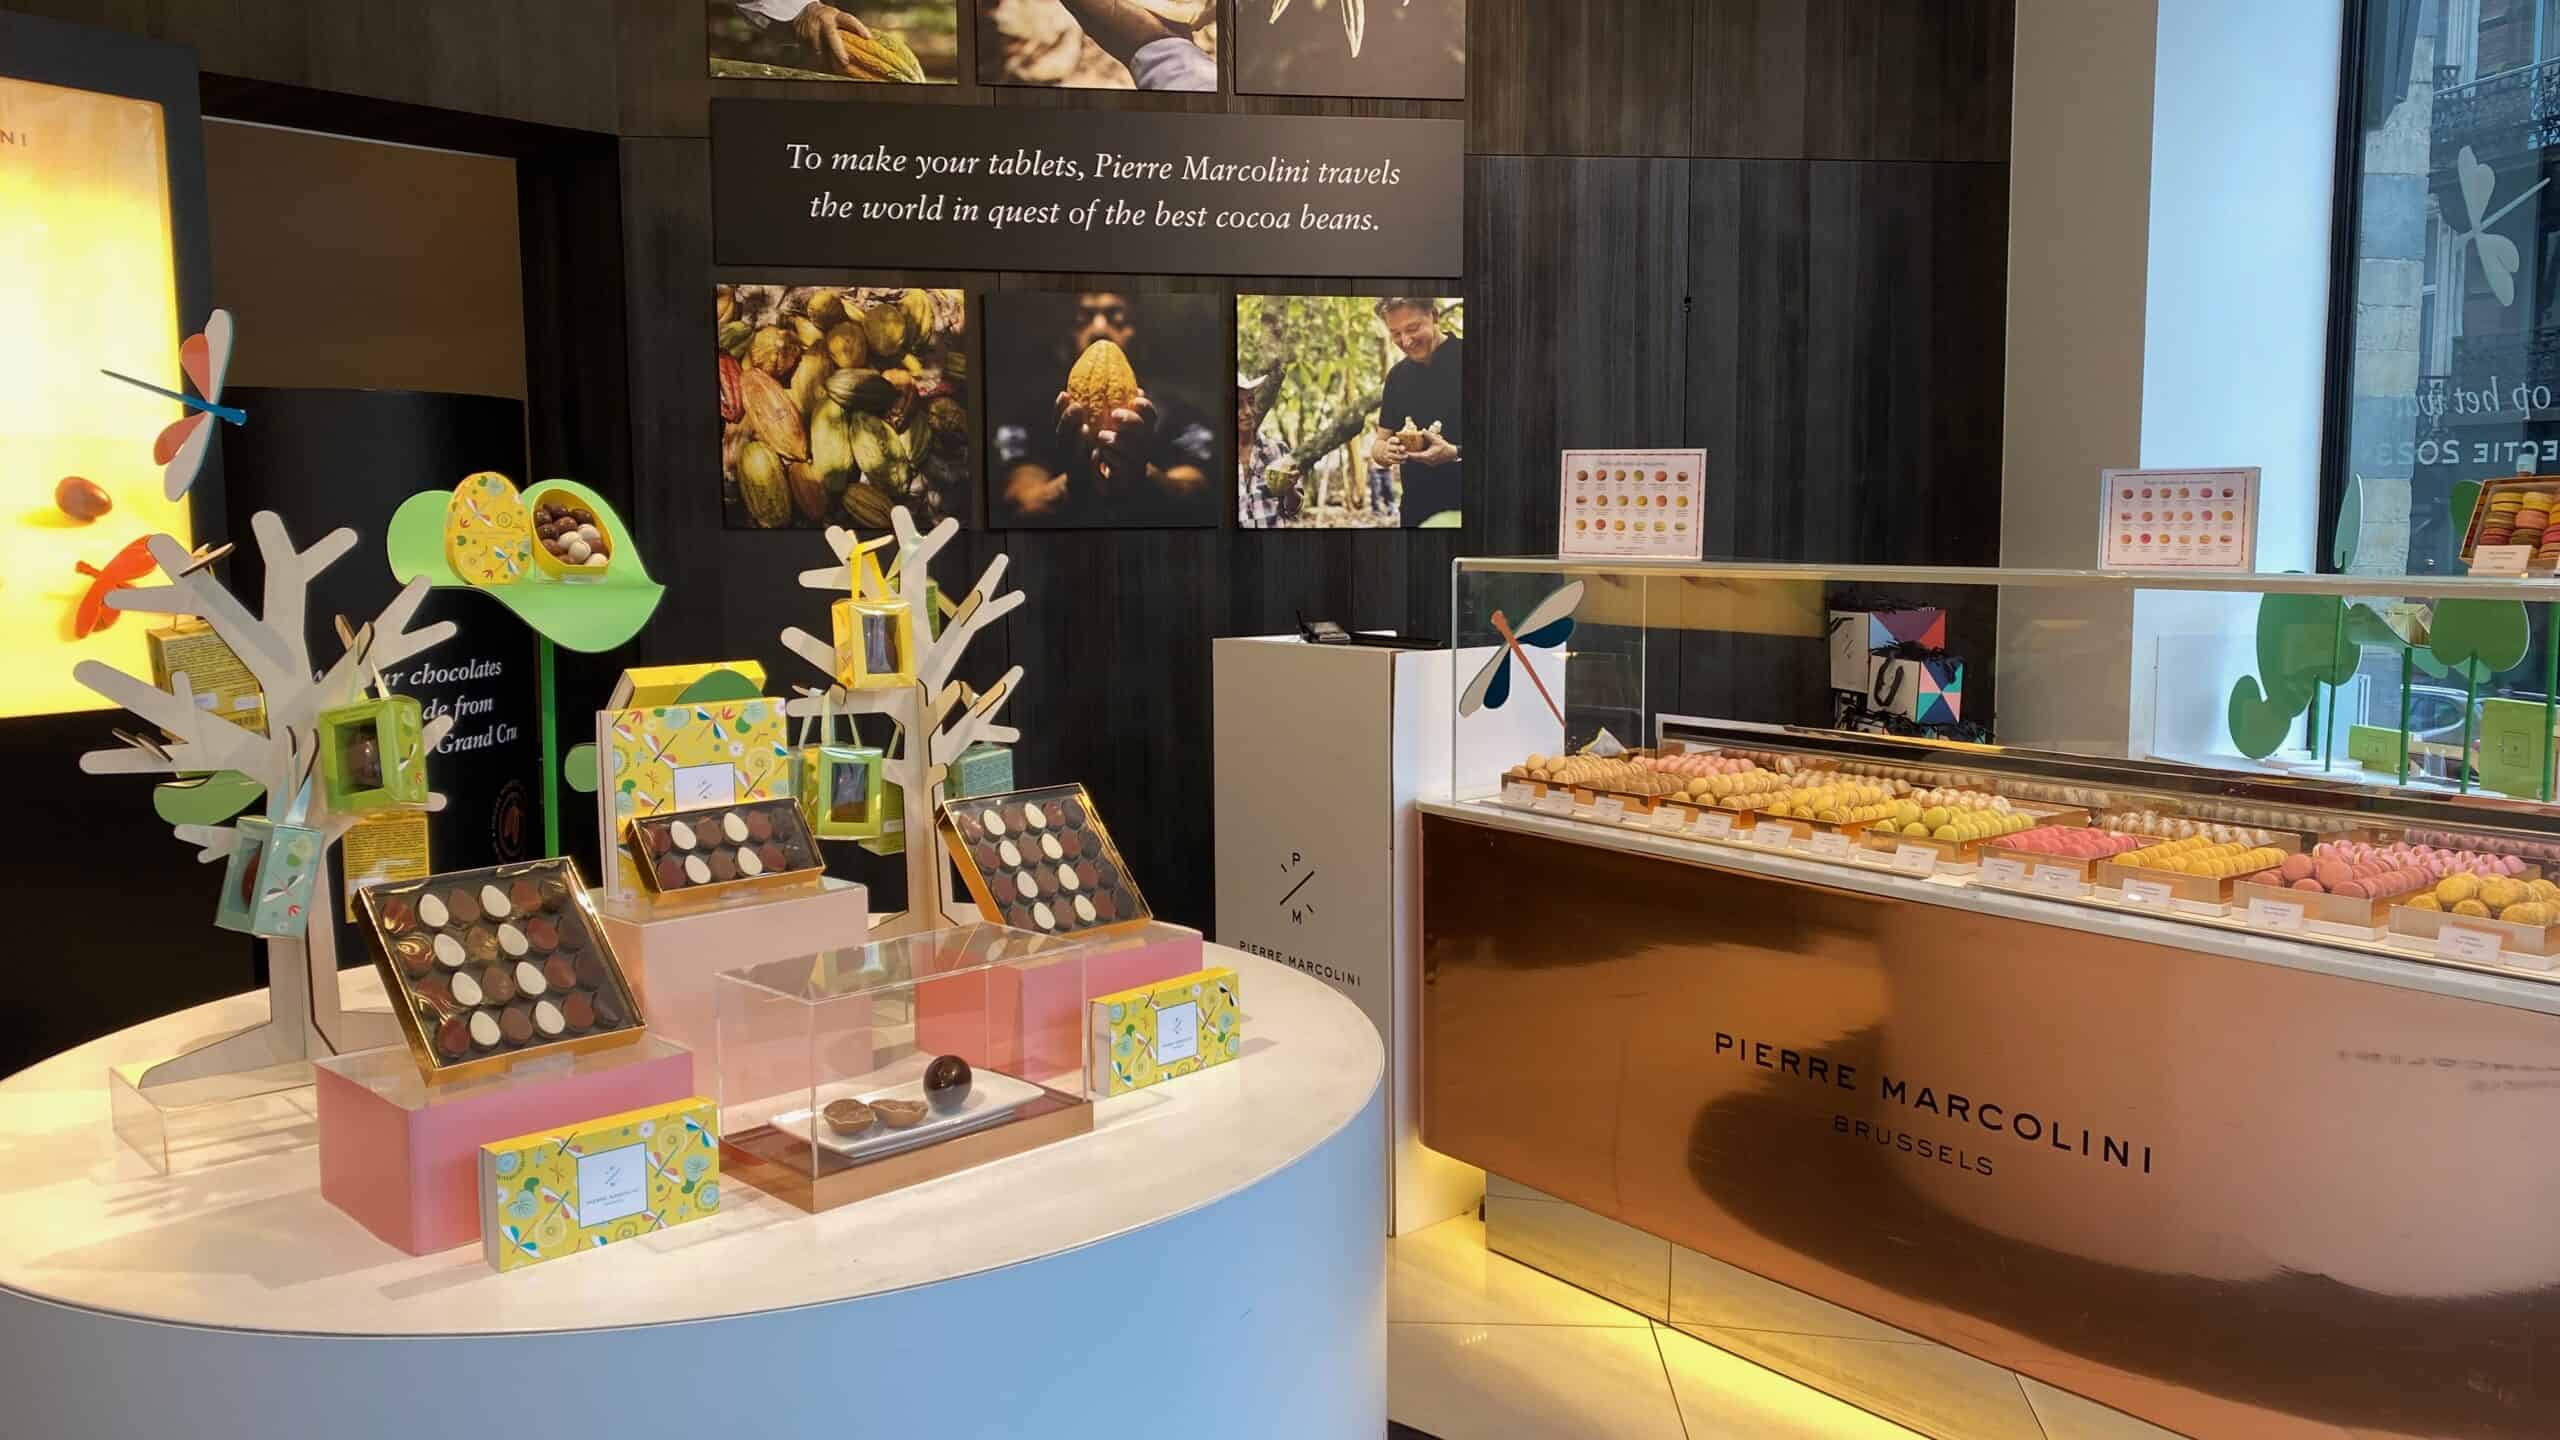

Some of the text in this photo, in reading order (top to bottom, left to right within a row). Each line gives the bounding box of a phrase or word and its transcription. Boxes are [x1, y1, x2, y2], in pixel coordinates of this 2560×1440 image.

[786, 143, 1400, 185] To make your tablets, Pierre Marcolini travels
[810, 191, 1380, 231] the world in quest of the best cocoa beans.
[409, 658, 502, 686] chocolates
[422, 695, 494, 722] de from
[435, 723, 518, 754] Grand Cru
[1291, 852, 1301, 867] P
[1291, 909, 1302, 925] M
[1239, 940, 1362, 987] PIERRE MARCOLINI
[1714, 1031, 2153, 1174] PIERRE MARCOLINI
[1834, 1114, 1994, 1177] BRUSSELS
